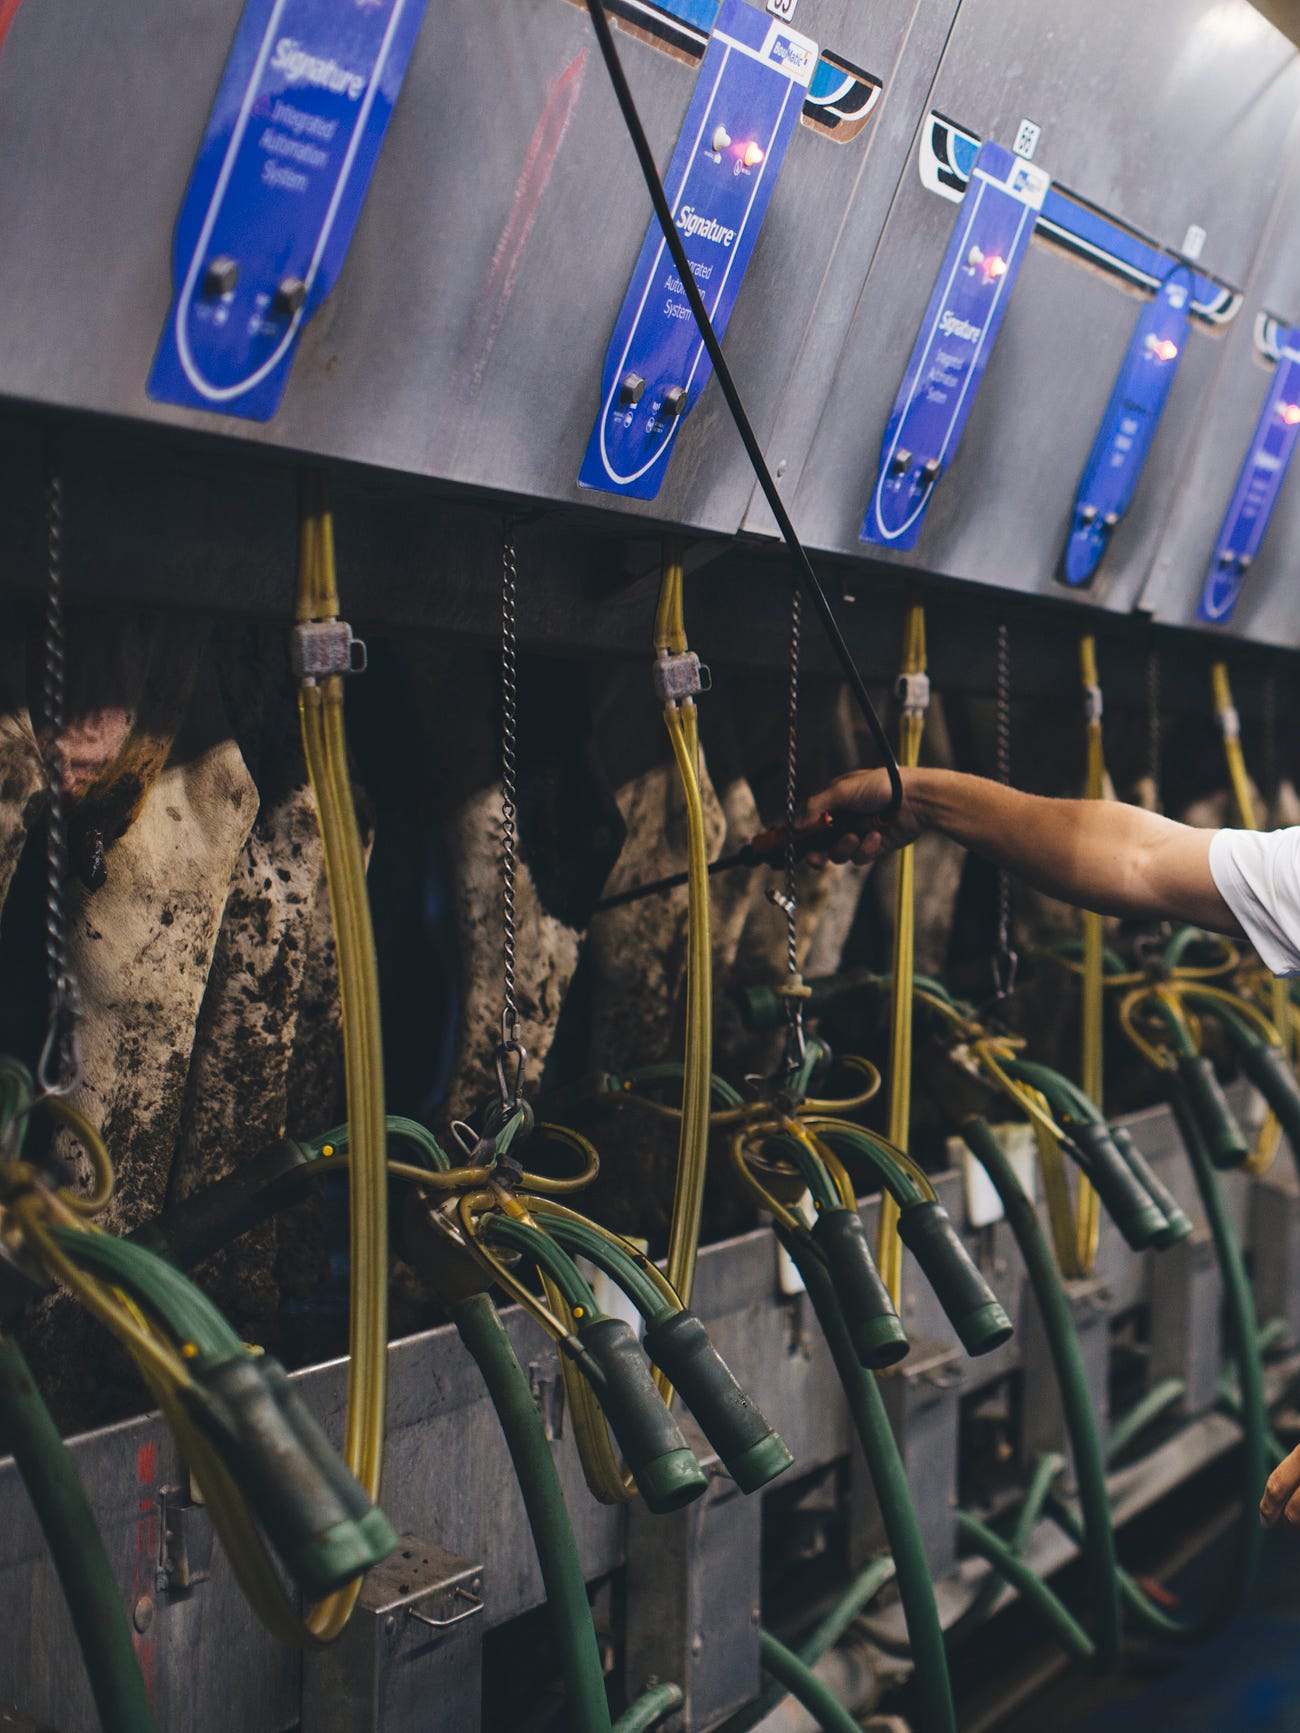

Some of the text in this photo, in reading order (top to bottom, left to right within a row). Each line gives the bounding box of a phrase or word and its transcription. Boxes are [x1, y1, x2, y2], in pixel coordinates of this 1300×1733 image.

[270, 37, 365, 100] Signature
[773, 41, 804, 67] BouMatic
[271, 100, 339, 142] Integrated
[258, 128, 329, 168] Automation
[261, 159, 309, 193] System
[676, 205, 734, 247] Signature
[663, 299, 692, 321] System
[939, 310, 981, 343] Signature
